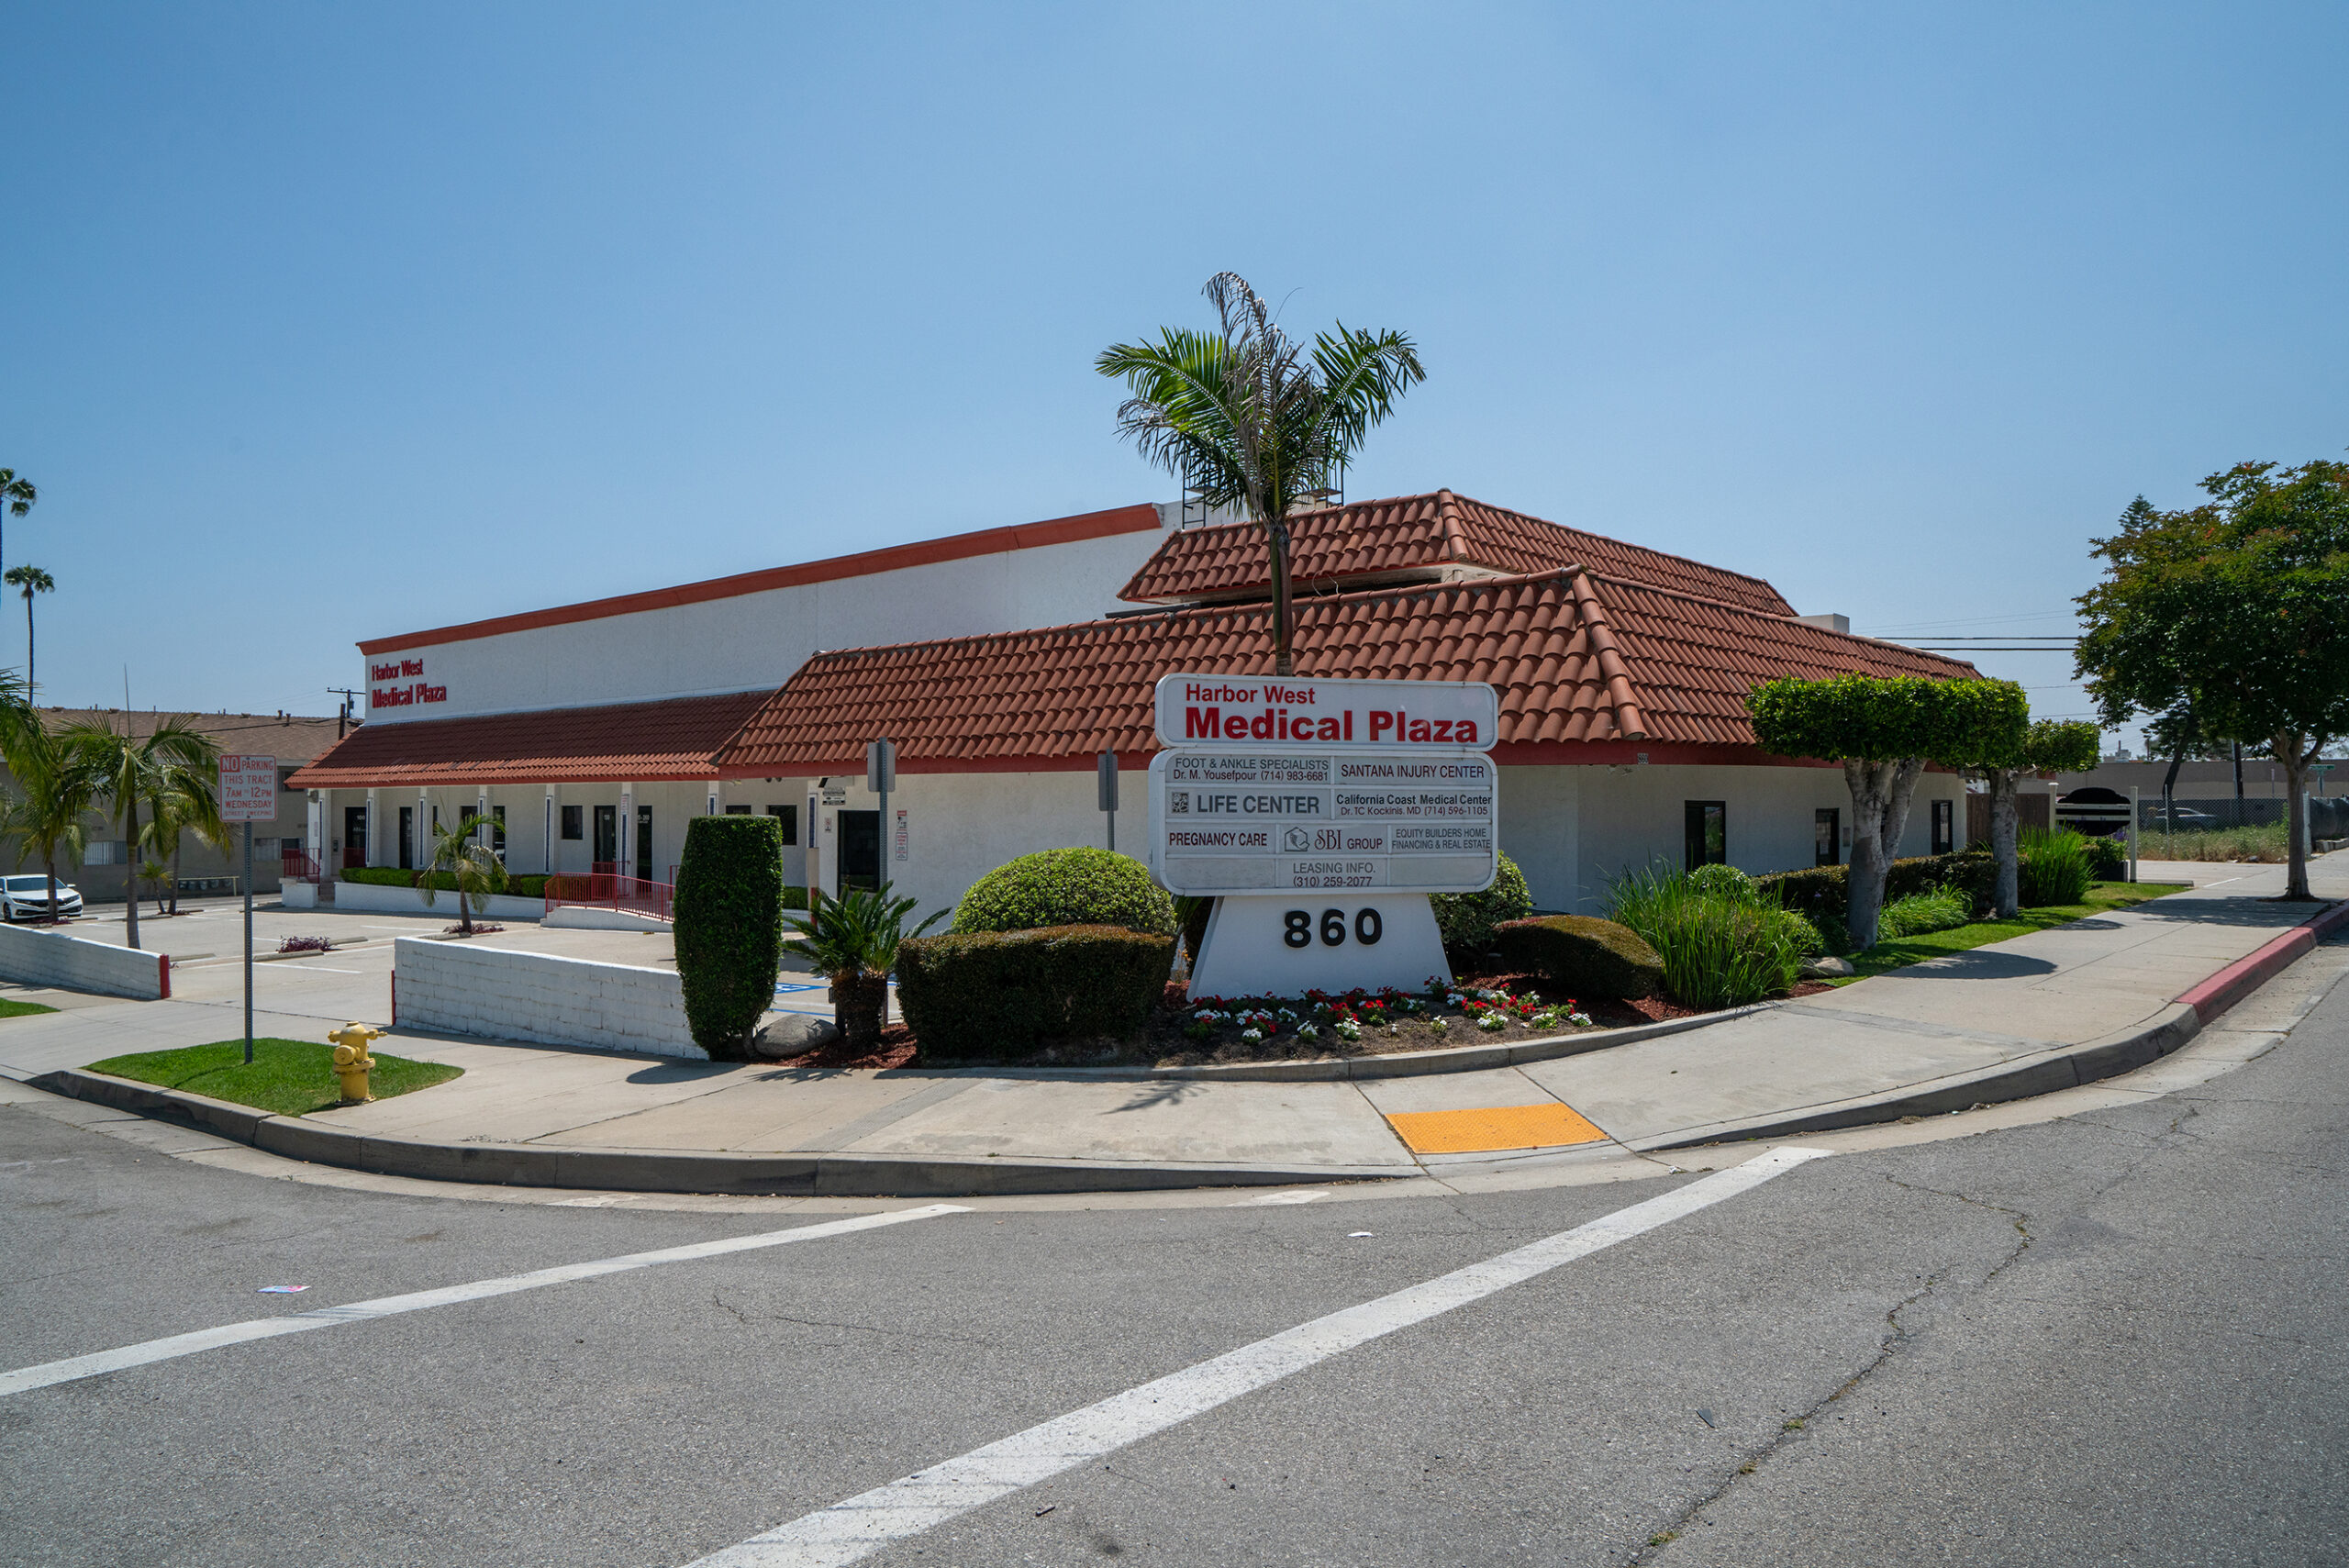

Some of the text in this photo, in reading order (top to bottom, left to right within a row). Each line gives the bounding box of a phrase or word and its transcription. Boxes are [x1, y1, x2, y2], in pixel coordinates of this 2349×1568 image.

[372, 659, 424, 682] Harbor West
[372, 683, 447, 708] Medical Plaza
[1186, 684, 1316, 705] Harbor West
[1186, 706, 1478, 743] Medical Plaza
[222, 757, 273, 772] NO PARKING
[1175, 758, 1329, 770] FOOT & ANKLE SPECIALISTS
[1174, 770, 1329, 783] Dr. M. Yousefpour (714) 983-6681
[1341, 764, 1485, 778] SANTANA INJURY CENTER
[224, 775, 273, 784] THIS TRACT
[225, 800, 273, 808] WEDNESDAY
[1197, 795, 1319, 814] LIFE CENTER
[1336, 794, 1492, 805] California Coast Medical Center
[1341, 806, 1353, 815] Dr.
[1354, 806, 1365, 815] TC
[1407, 806, 1421, 815] MD
[1424, 806, 1446, 816] (714)
[1448, 806, 1488, 815] 596-1105
[1169, 832, 1267, 846] PREGNANCY CARE
[1314, 829, 1384, 851] SBI GROUP
[1396, 828, 1486, 839] EQUITY BUILDERS HOME
[1392, 840, 1491, 850] FINANCING & REAL ESTATE
[1293, 862, 1376, 873] LEASING INFO.
[1293, 876, 1373, 887] (310) 259-2077
[1284, 908, 1383, 949] 860
